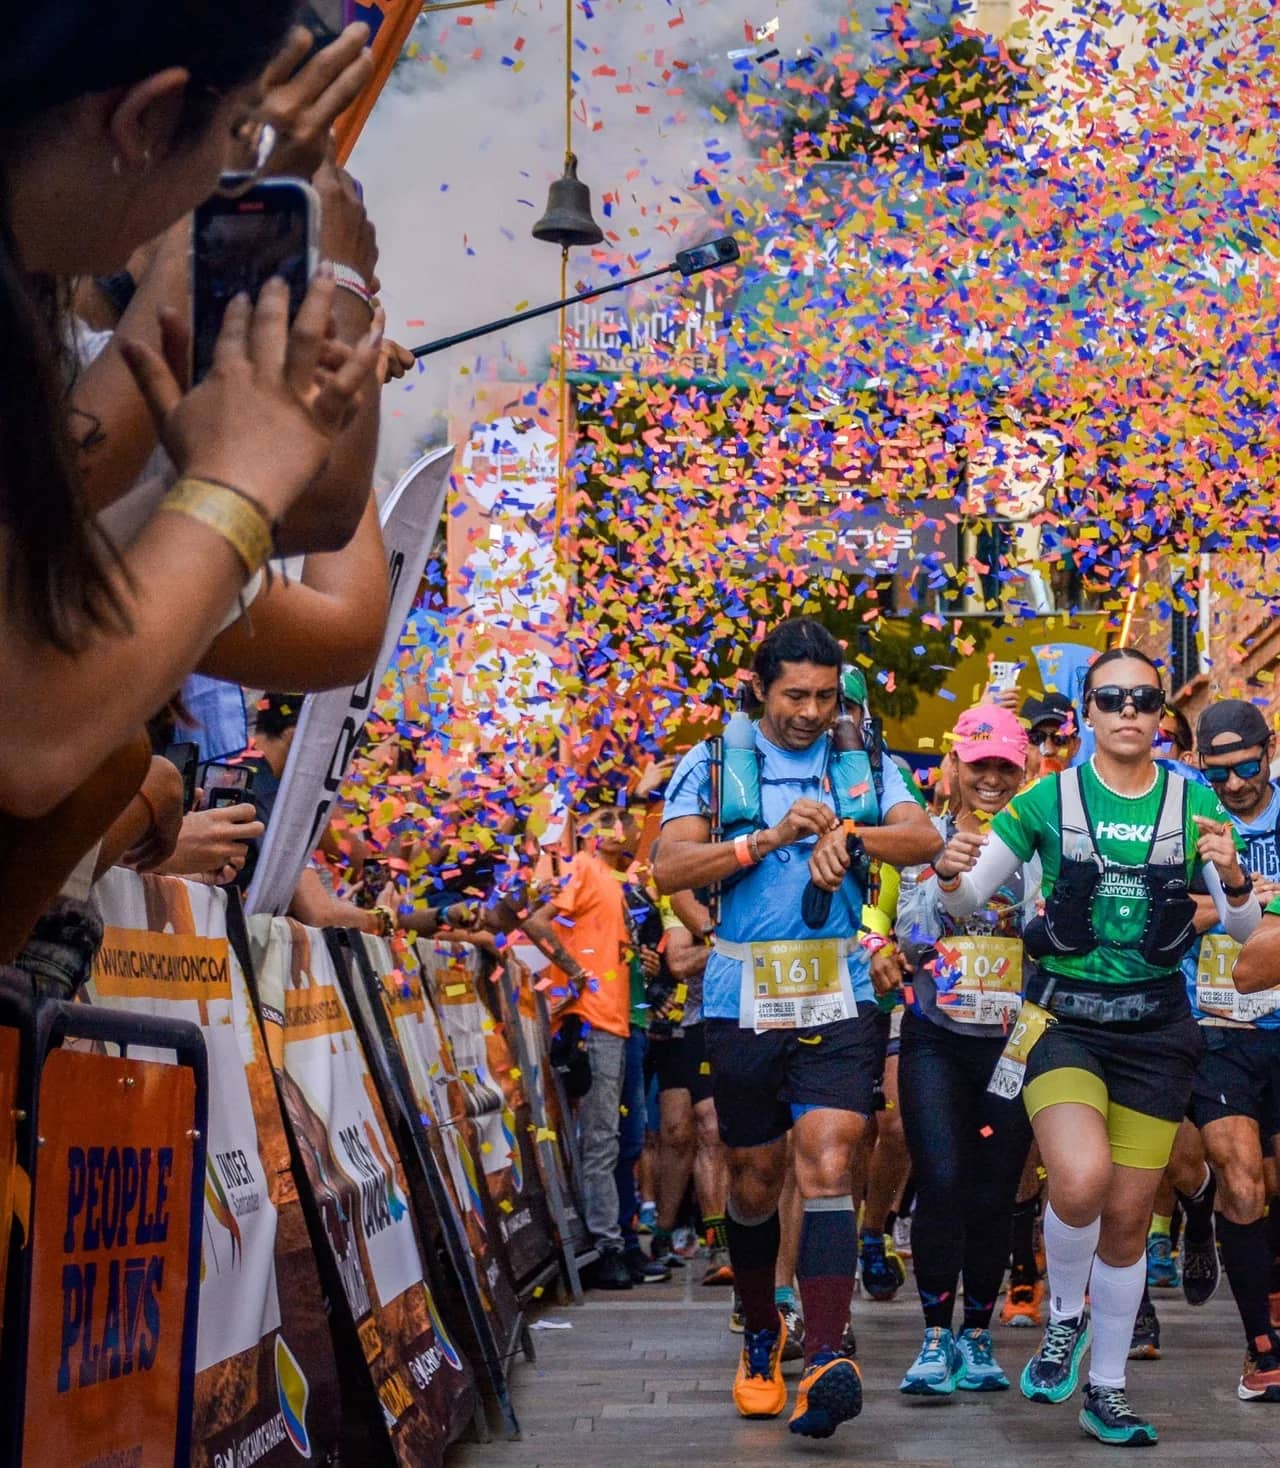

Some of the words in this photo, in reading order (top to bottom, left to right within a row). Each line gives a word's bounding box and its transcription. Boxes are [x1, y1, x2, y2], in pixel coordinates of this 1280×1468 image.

[1098, 886, 1135, 896] CANYON
[770, 957, 821, 985] 161
[215, 1149, 256, 1190] INDER
[64, 1146, 174, 1254] PEOPLE
